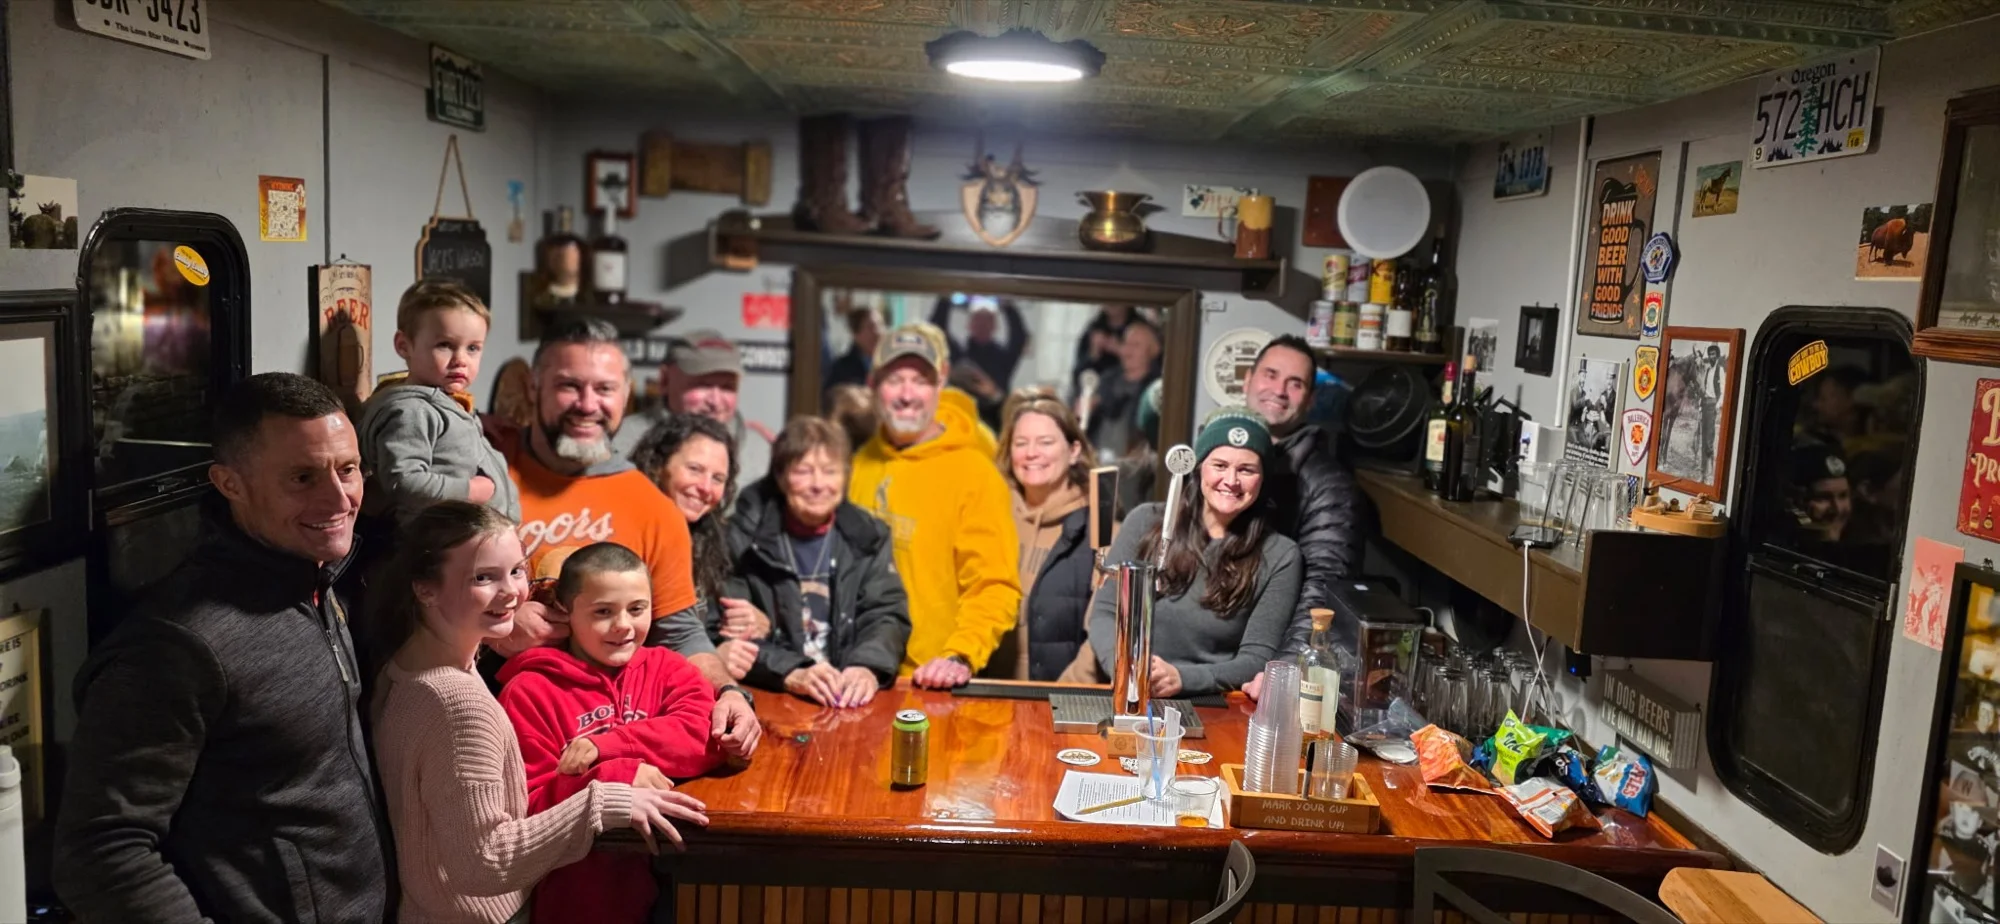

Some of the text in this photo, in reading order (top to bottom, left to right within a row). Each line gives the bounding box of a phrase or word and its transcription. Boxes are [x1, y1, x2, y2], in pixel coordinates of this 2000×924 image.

[1791, 62, 1836, 84] Oregon
[1754, 70, 1871, 145] 572 HCH
[1755, 147, 1763, 160] 9
[1602, 200, 1635, 226] DRINK
[1601, 227, 1628, 245] GOOD
[1599, 245, 1627, 266] BEER
[1597, 266, 1623, 284] WITH
[1595, 285, 1621, 302] GOOD
[324, 298, 369, 330] BEER
[1591, 303, 1623, 319] FRIENDS
[1790, 350, 1826, 382] COWBOY
[1627, 413, 1649, 427] BILLERICA
[1970, 452, 2000, 488] PR
[516, 507, 614, 556] oors
[1604, 673, 1672, 740] IN DOG BEERS,
[1617, 711, 1636, 739] ONLY
[1637, 722, 1653, 750] HAD
[1262, 800, 1348, 815] MARK YOUR CUP
[1264, 815, 1345, 831] AND DRINK UP!
